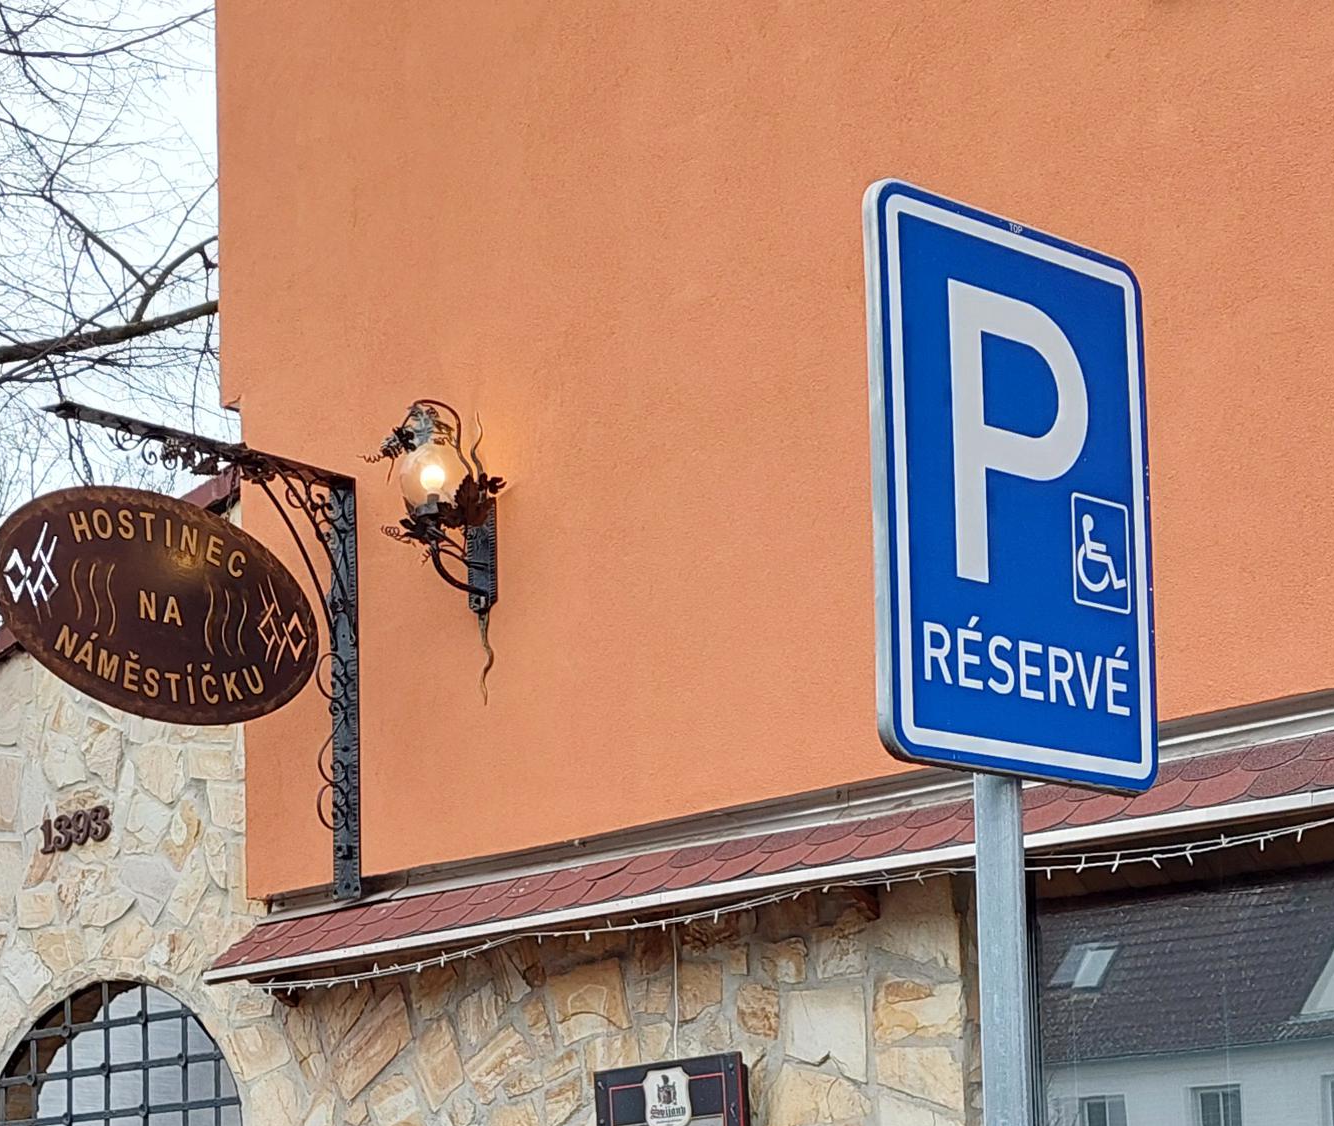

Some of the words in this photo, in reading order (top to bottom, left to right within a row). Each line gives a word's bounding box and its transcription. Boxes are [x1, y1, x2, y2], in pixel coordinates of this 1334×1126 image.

[1009, 222, 1023, 234] TOP
[948, 277, 1088, 583] P
[69, 508, 248, 579] HOSTINEC
[139, 590, 183, 627] NA
[54, 624, 264, 705] NÁMĚSTÍČKU
[923, 615, 1130, 717] RÉSERVÉ
[40, 805, 111, 855] 1393
